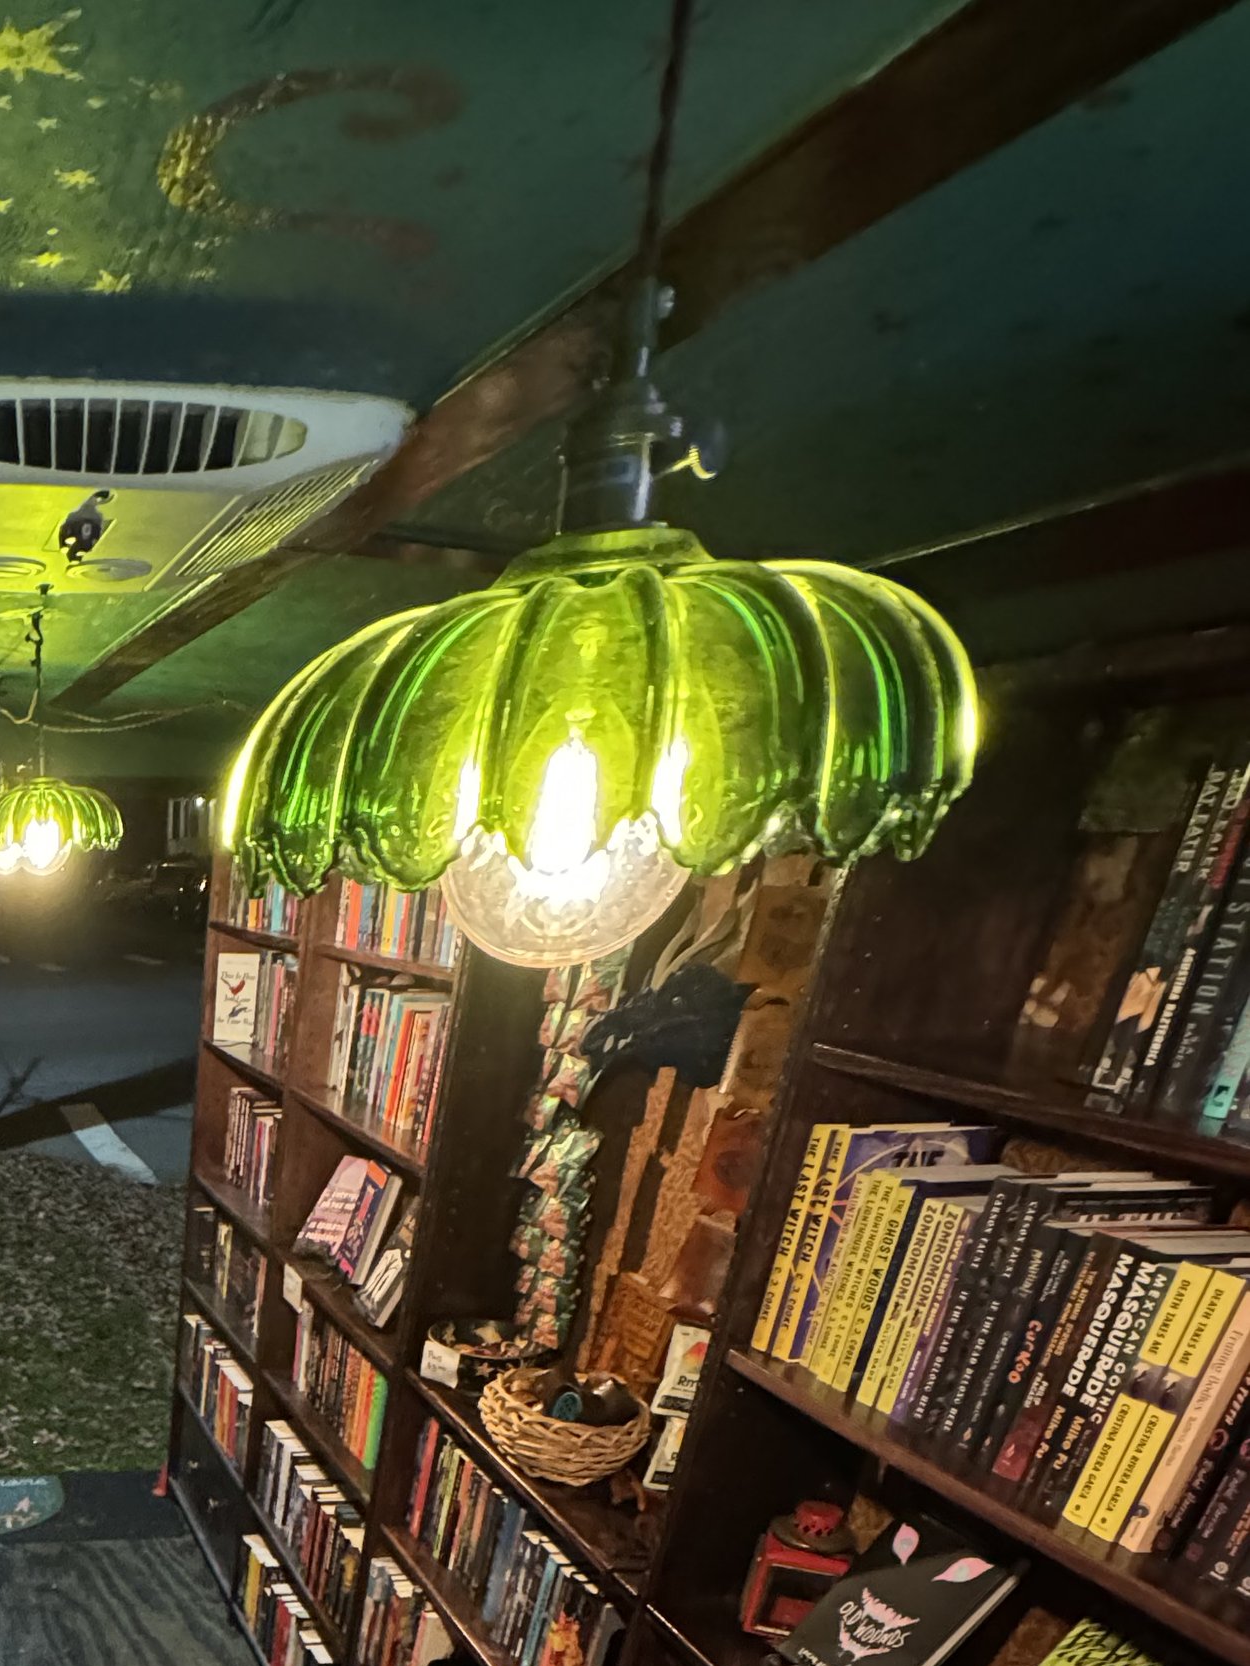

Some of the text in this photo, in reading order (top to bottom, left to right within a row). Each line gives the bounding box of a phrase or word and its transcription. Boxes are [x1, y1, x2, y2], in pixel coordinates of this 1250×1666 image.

[1188, 897, 1250, 1019] STATION
[806, 1135, 821, 1158] THE
[830, 1140, 842, 1162] THE
[791, 1161, 814, 1203] LAST
[814, 1166, 836, 1208] LAST
[868, 1178, 881, 1198] THE
[879, 1184, 893, 1205] THE
[892, 1198, 905, 1215] THE
[982, 1191, 1006, 1234] CARSON
[1014, 1199, 1038, 1244] CARSON
[776, 1205, 801, 1257] WITCH
[798, 1210, 823, 1263] WITCH
[848, 1199, 874, 1258] LIGHTHOUSE
[859, 1205, 886, 1264] LIGHTHOUSE
[876, 1218, 900, 1262] GHOST
[893, 1203, 938, 1303] ZOMROMCOM
[913, 1210, 959, 1310] ZOMROMCOM
[969, 1236, 989, 1269] FAUST
[1001, 1245, 1021, 1279] FAUST
[835, 1260, 854, 1300] WITCHES
[844, 1267, 865, 1308] WITCHES
[859, 1266, 883, 1312] WOODS
[1083, 1268, 1096, 1286] THE
[758, 1291, 775, 1322] COOKE
[780, 1297, 797, 1329] COOKE
[948, 1305, 963, 1326] THE
[1059, 1251, 1134, 1398] MASQUERADE
[1147, 1278, 1190, 1356] DEATH TAKES ME
[875, 1322, 893, 1355] OLIVIA
[937, 1325, 955, 1354] DEAD
[978, 1315, 995, 1337] THE
[1078, 1259, 1156, 1409] MASQUERADE
[1177, 1286, 1224, 1367] DEATH TAKES ME
[842, 1338, 857, 1366] COOKE
[895, 1329, 913, 1362] OLIVIA
[968, 1336, 986, 1365] DEAD
[1088, 1272, 1168, 1426] MEXICAN GOTHIC
[922, 1354, 944, 1394] BELONG
[912, 1393, 929, 1420] HERE
[940, 1406, 958, 1433] HERE
[1042, 1404, 1066, 1440] Mike
[1105, 1402, 1131, 1443] CRISTINA
[1033, 1440, 1050, 1460] Fu
[1060, 1414, 1085, 1452] Mike
[1051, 1451, 1069, 1471] Fu
[1091, 1441, 1112, 1472] RIVERA
[1103, 1413, 1160, 1513] CRISTINA RIVERA GARZA
[1077, 1472, 1098, 1500] GARZA
[834, 1597, 912, 1660] OLD WOUNDS
